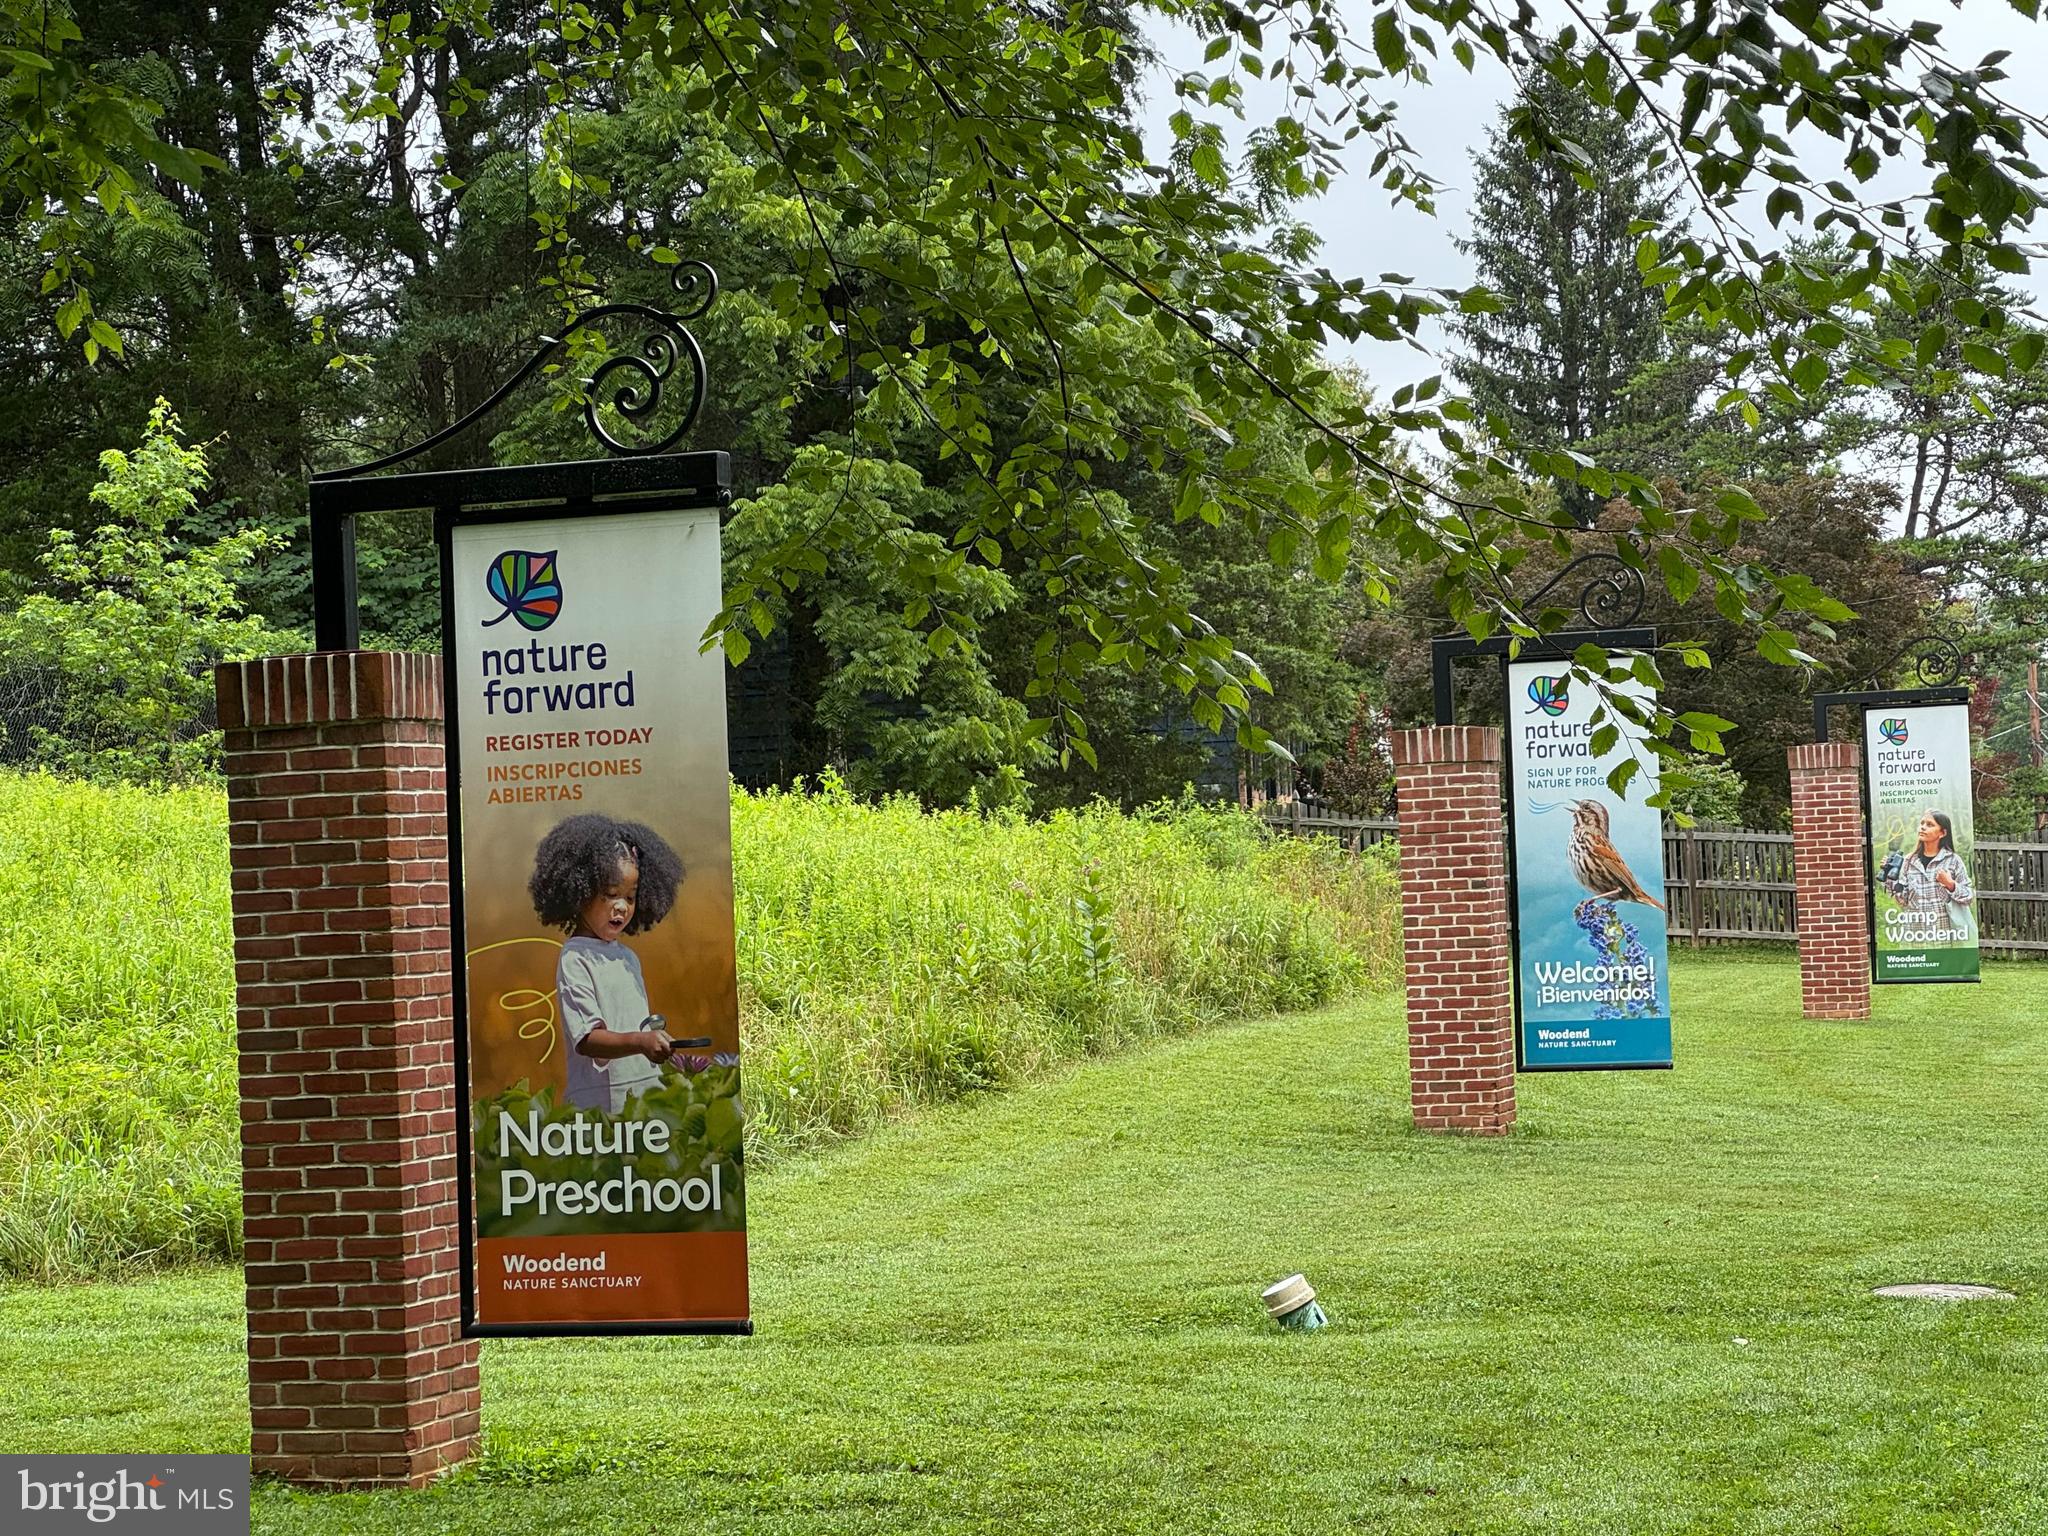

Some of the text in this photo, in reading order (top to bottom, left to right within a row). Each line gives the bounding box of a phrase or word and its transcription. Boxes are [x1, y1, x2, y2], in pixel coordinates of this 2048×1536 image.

[482, 638, 607, 676] nature
[483, 670, 635, 714] forward
[1525, 720, 1592, 739] nature
[486, 727, 653, 752] REGISTER TODAY
[1526, 741, 1592, 759] forwa
[1878, 748, 1925, 761] nature
[487, 758, 642, 782] INSCRIPCIONES
[1528, 766, 1597, 777] SIGN UP FOR
[1879, 759, 1936, 774] forward
[1528, 777, 1636, 789] NATURE PROGS
[487, 784, 583, 804] ABIERTAS
[1880, 788, 1938, 797] INSCRIPCIONES
[1885, 908, 1938, 926] Camp
[1885, 925, 1969, 942] Woodend
[1886, 954, 1926, 963] Woodend
[1534, 957, 1655, 984] Welcome!
[1536, 983, 1655, 1007] ¡Bienvenidos!
[1538, 1028, 1590, 1040] Woodend
[499, 1110, 670, 1157] Nature
[501, 1164, 722, 1216] Preschool
[503, 1251, 606, 1273] Woodend
[503, 1276, 642, 1290] NATURE SANCTUARY
